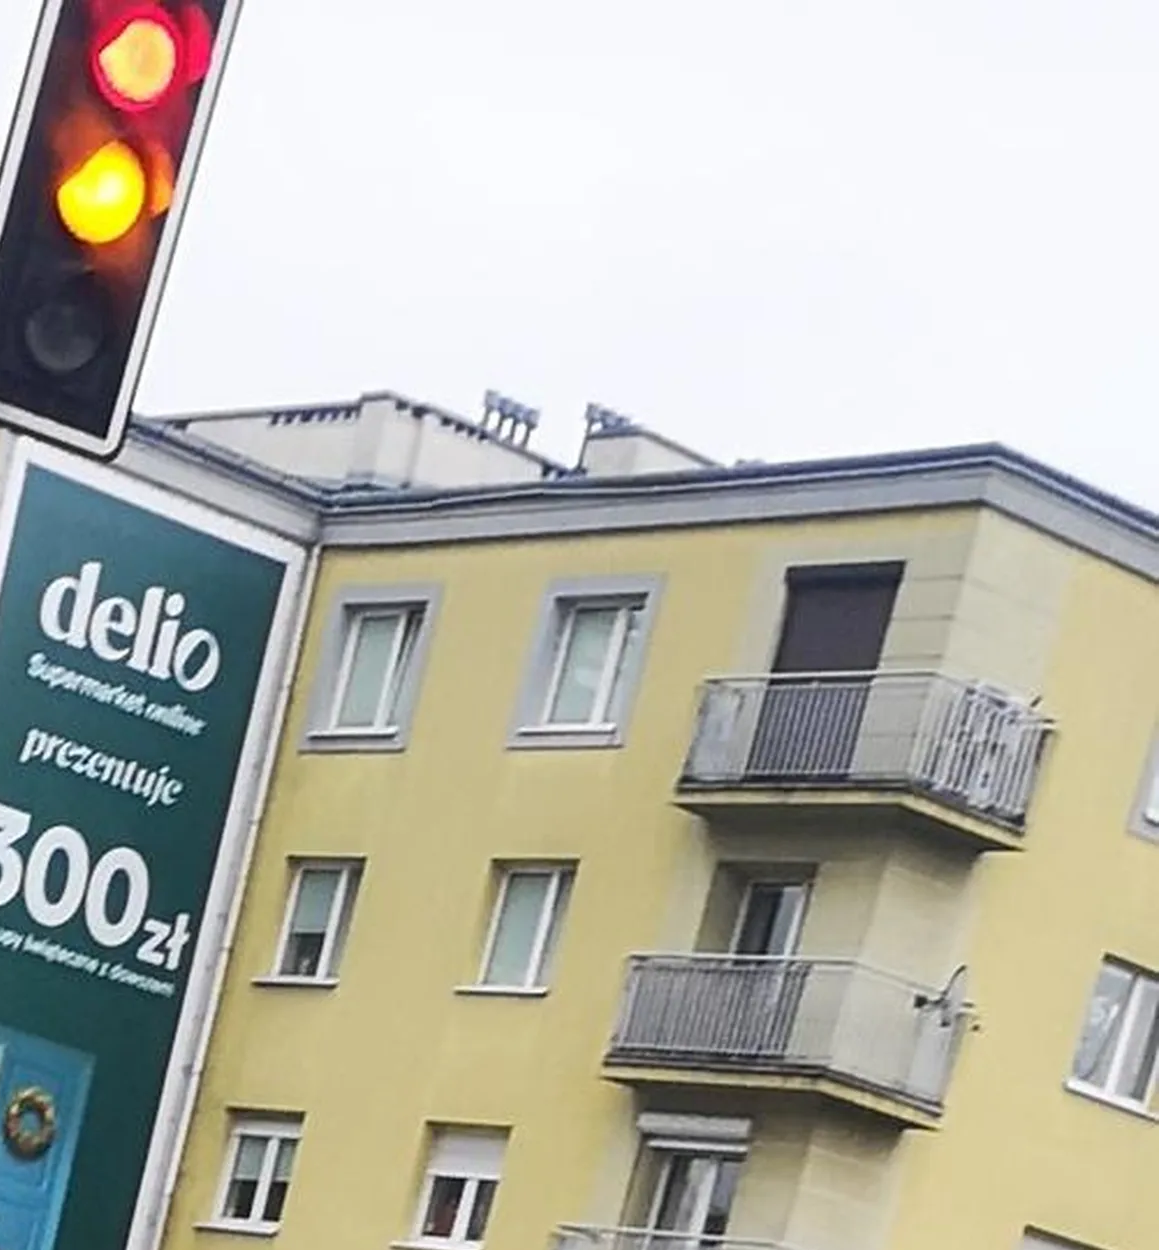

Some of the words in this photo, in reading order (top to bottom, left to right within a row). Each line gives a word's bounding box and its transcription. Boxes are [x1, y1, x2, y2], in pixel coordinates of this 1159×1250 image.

[40, 562, 221, 691] delio
[26, 651, 147, 715] Supermarket
[19, 727, 184, 807] prezentuje
